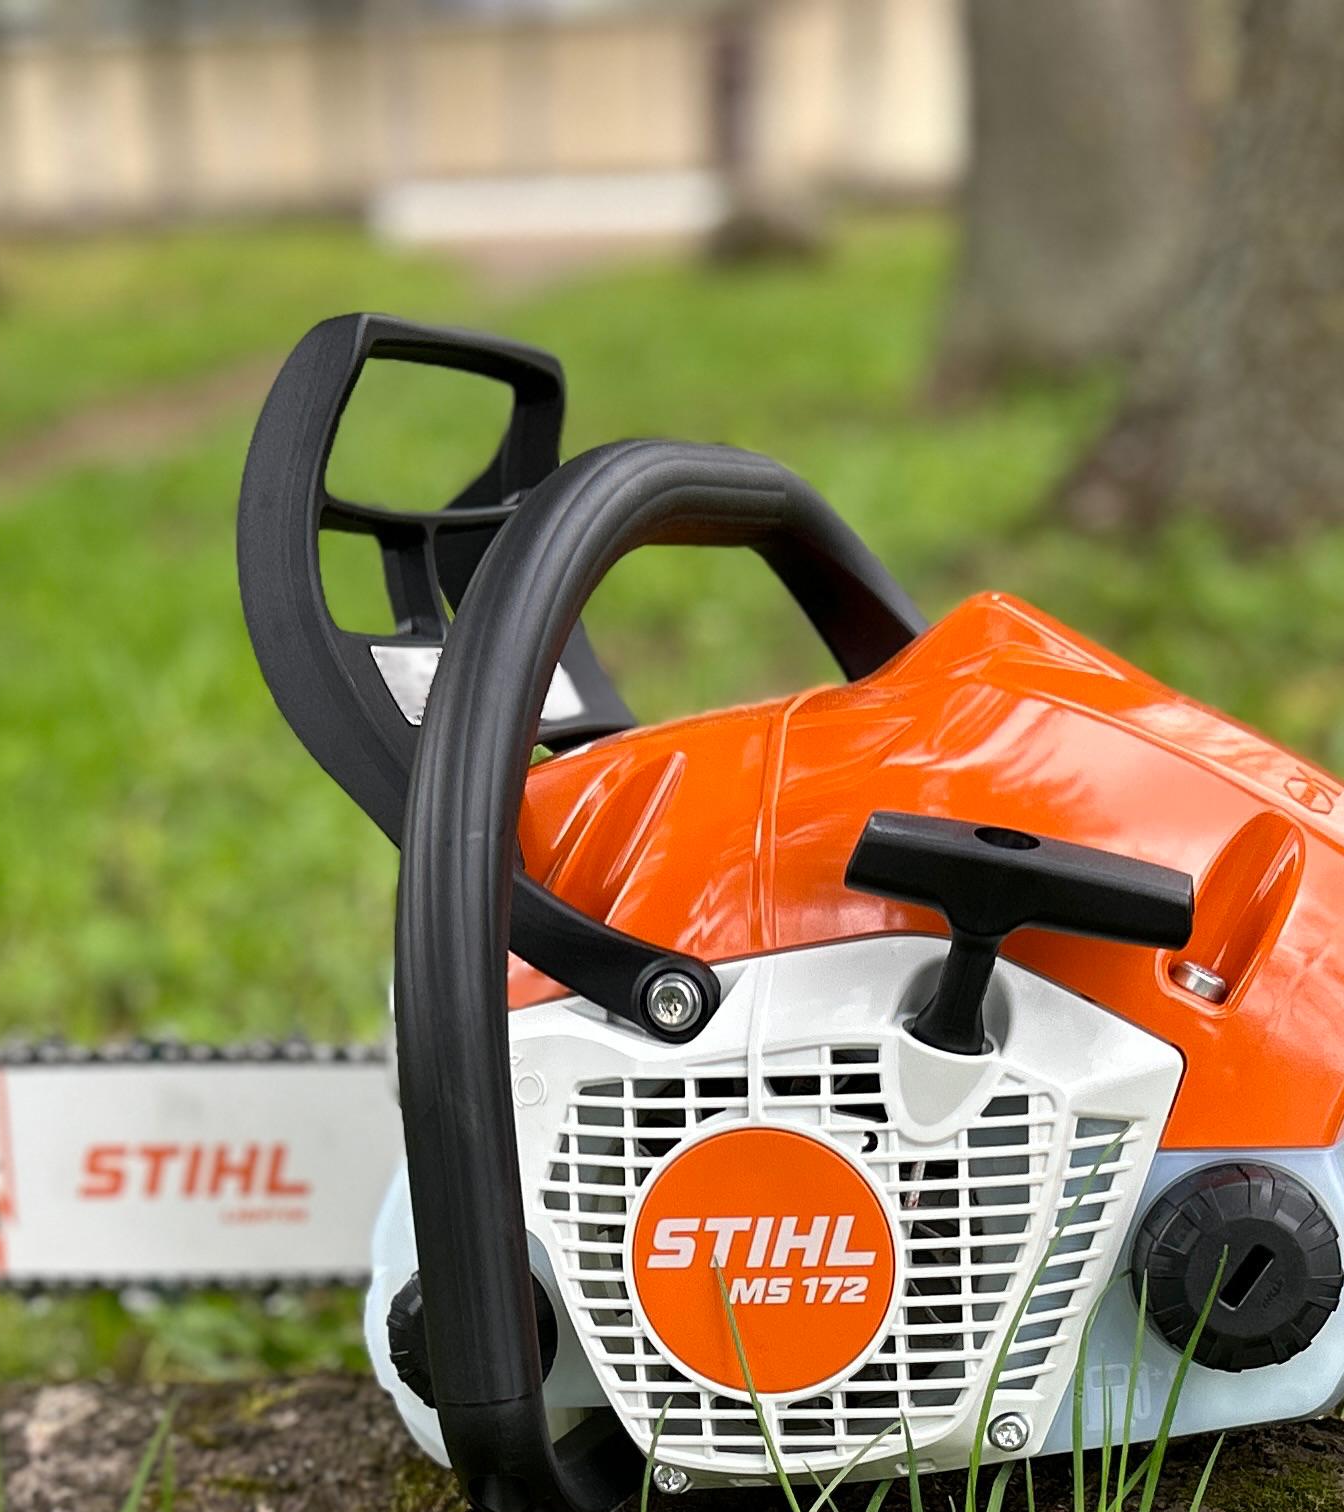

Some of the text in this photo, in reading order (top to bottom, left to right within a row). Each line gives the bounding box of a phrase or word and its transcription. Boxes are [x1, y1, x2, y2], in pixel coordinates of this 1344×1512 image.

[79, 1143, 312, 1200] STIHL
[646, 1215, 877, 1268] STIHL
[729, 1276, 869, 1305] MS 172
